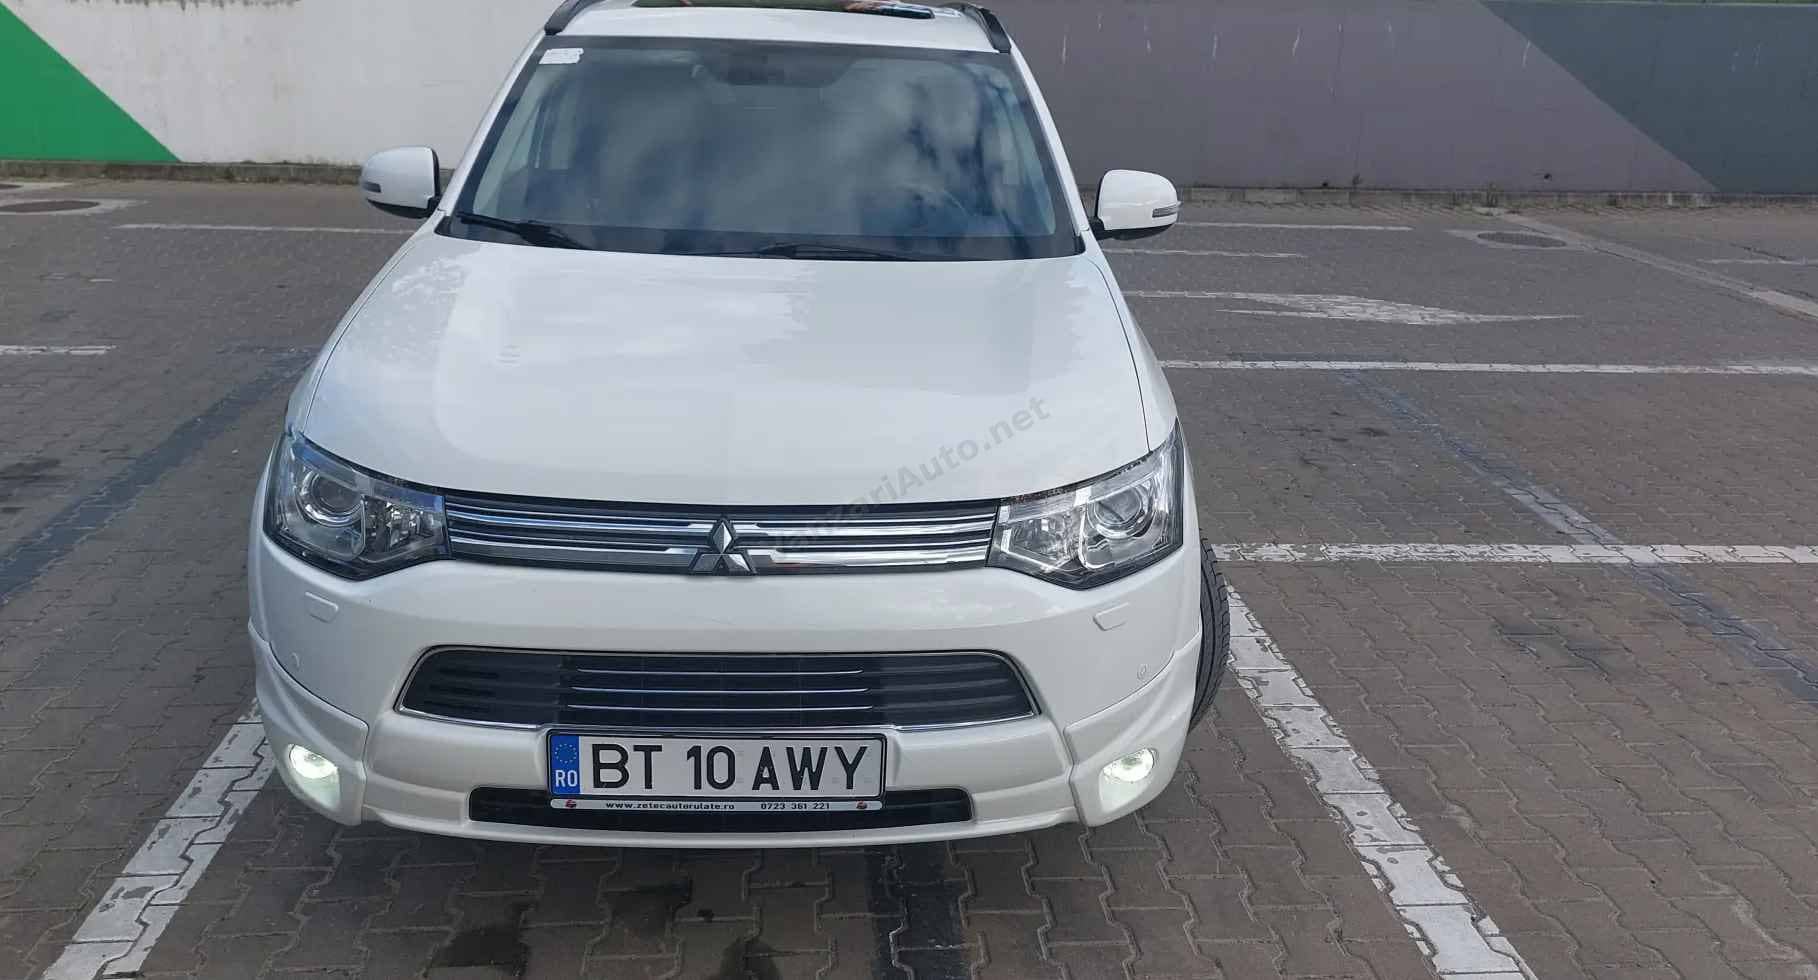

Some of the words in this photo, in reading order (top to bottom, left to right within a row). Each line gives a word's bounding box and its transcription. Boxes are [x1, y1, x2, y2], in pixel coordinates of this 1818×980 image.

[591, 743, 663, 790] BT
[686, 745, 736, 790] 10
[751, 745, 869, 791] AWY
[554, 769, 578, 788] RO
[605, 801, 735, 810] www.zetecautorulate.ro
[760, 801, 786, 810] 0723
[813, 801, 831, 810] 221
